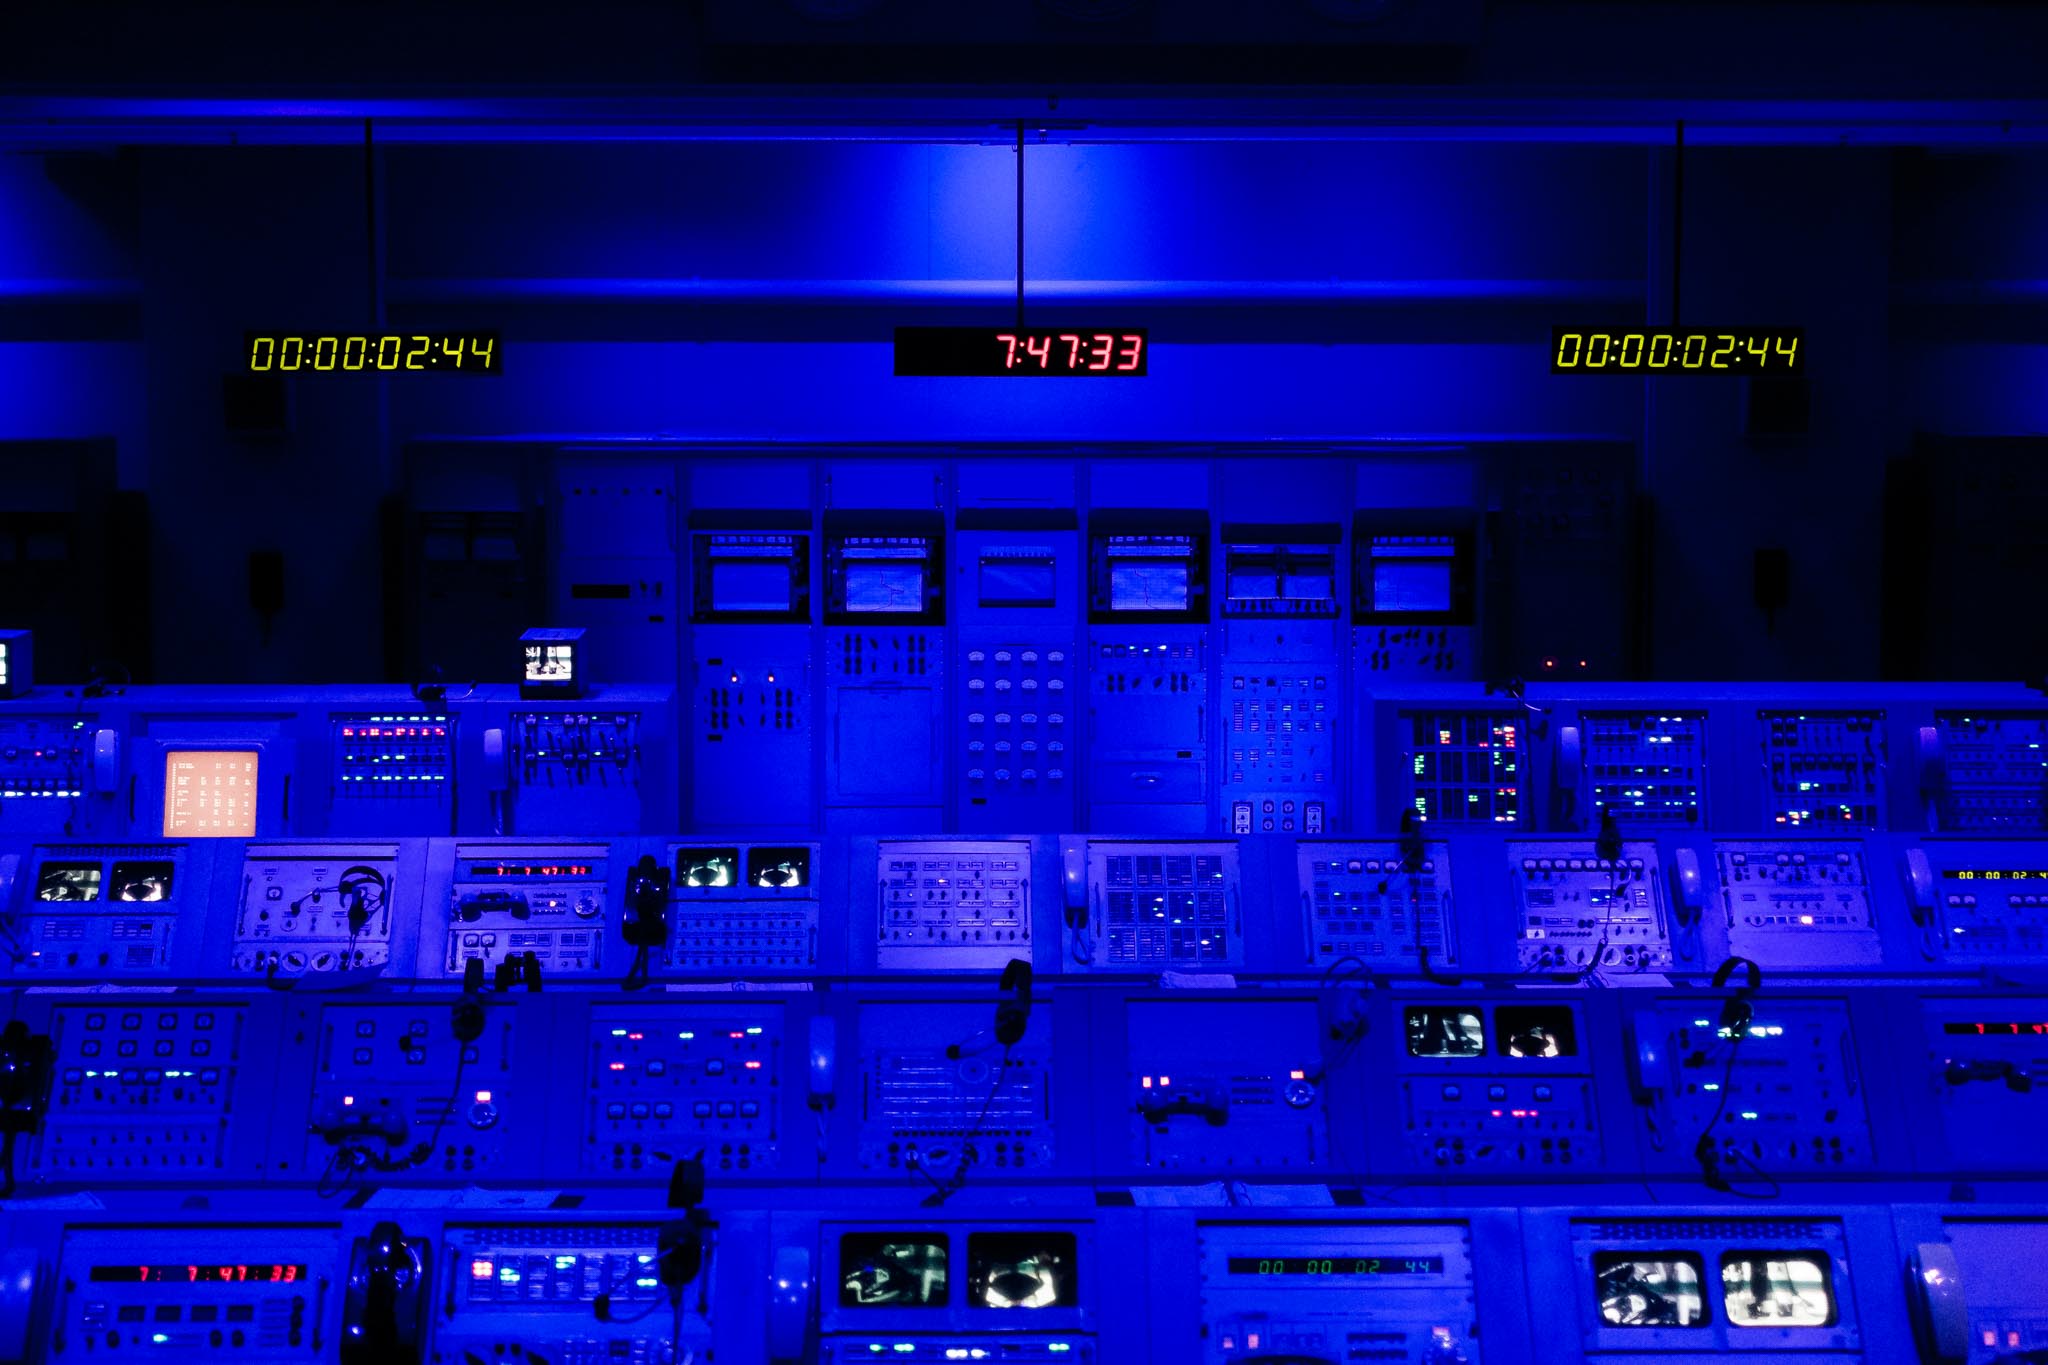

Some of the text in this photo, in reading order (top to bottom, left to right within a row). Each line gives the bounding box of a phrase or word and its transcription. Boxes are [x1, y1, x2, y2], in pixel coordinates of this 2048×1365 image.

[250, 336, 493, 370] 00:00:02:44
[996, 333, 1143, 370] 7:47:33
[1556, 333, 1798, 368] 00:00:02:44
